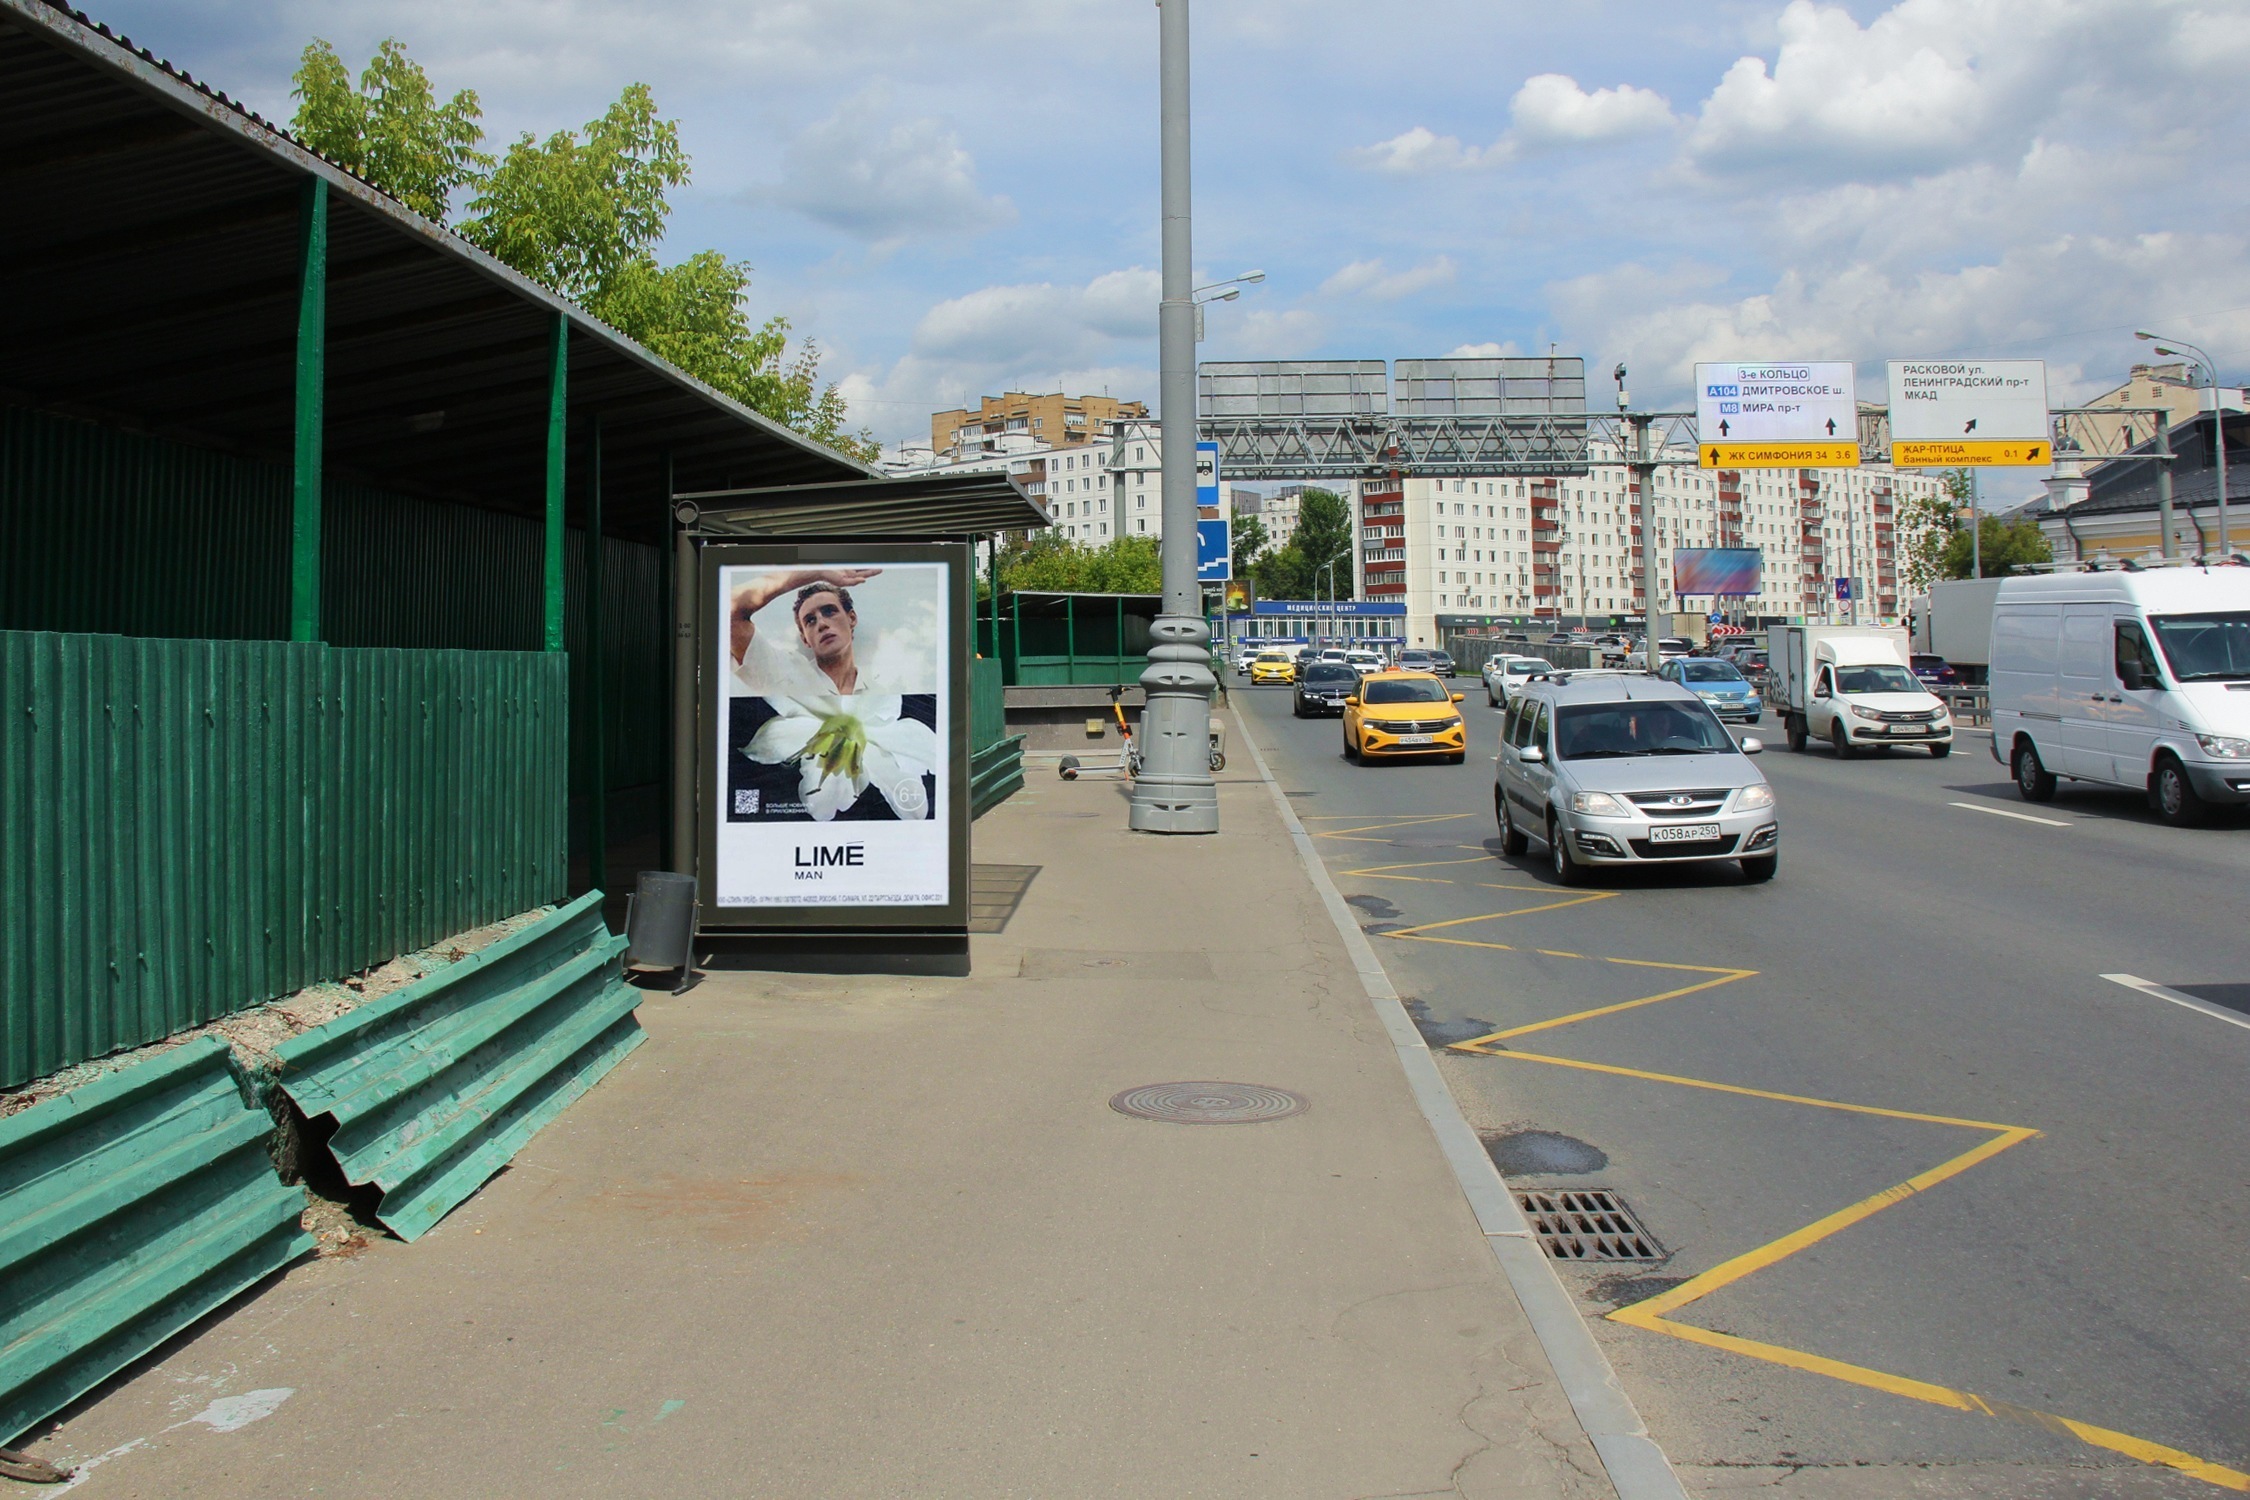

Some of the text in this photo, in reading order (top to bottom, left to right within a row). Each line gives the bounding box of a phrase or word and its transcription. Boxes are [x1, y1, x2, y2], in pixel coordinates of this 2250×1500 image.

[1740, 369, 1808, 381] 3-е КОЛЬЦО
[1903, 364, 1985, 376] РАСКОВОЙ ул.
[1903, 376, 2029, 389] ЛЕНИНГРАДСКИЙ пр-т
[1709, 385, 1846, 397] А104 ДМИТРОВСКОЕ ш.
[1904, 391, 1938, 401] МКАД
[1721, 403, 1801, 414] М8 МИРА пр-т
[1728, 450, 1851, 461] ЖК СИМФОНИЯ 34 3.6
[1903, 445, 2018, 458] ЖАР-ПТИЦА 0.1
[1903, 455, 1993, 465] банный комплекс
[1336, 605, 1357, 613] ЦЕНТР
[899, 786, 921, 803] 6+
[794, 870, 823, 880] MAN
